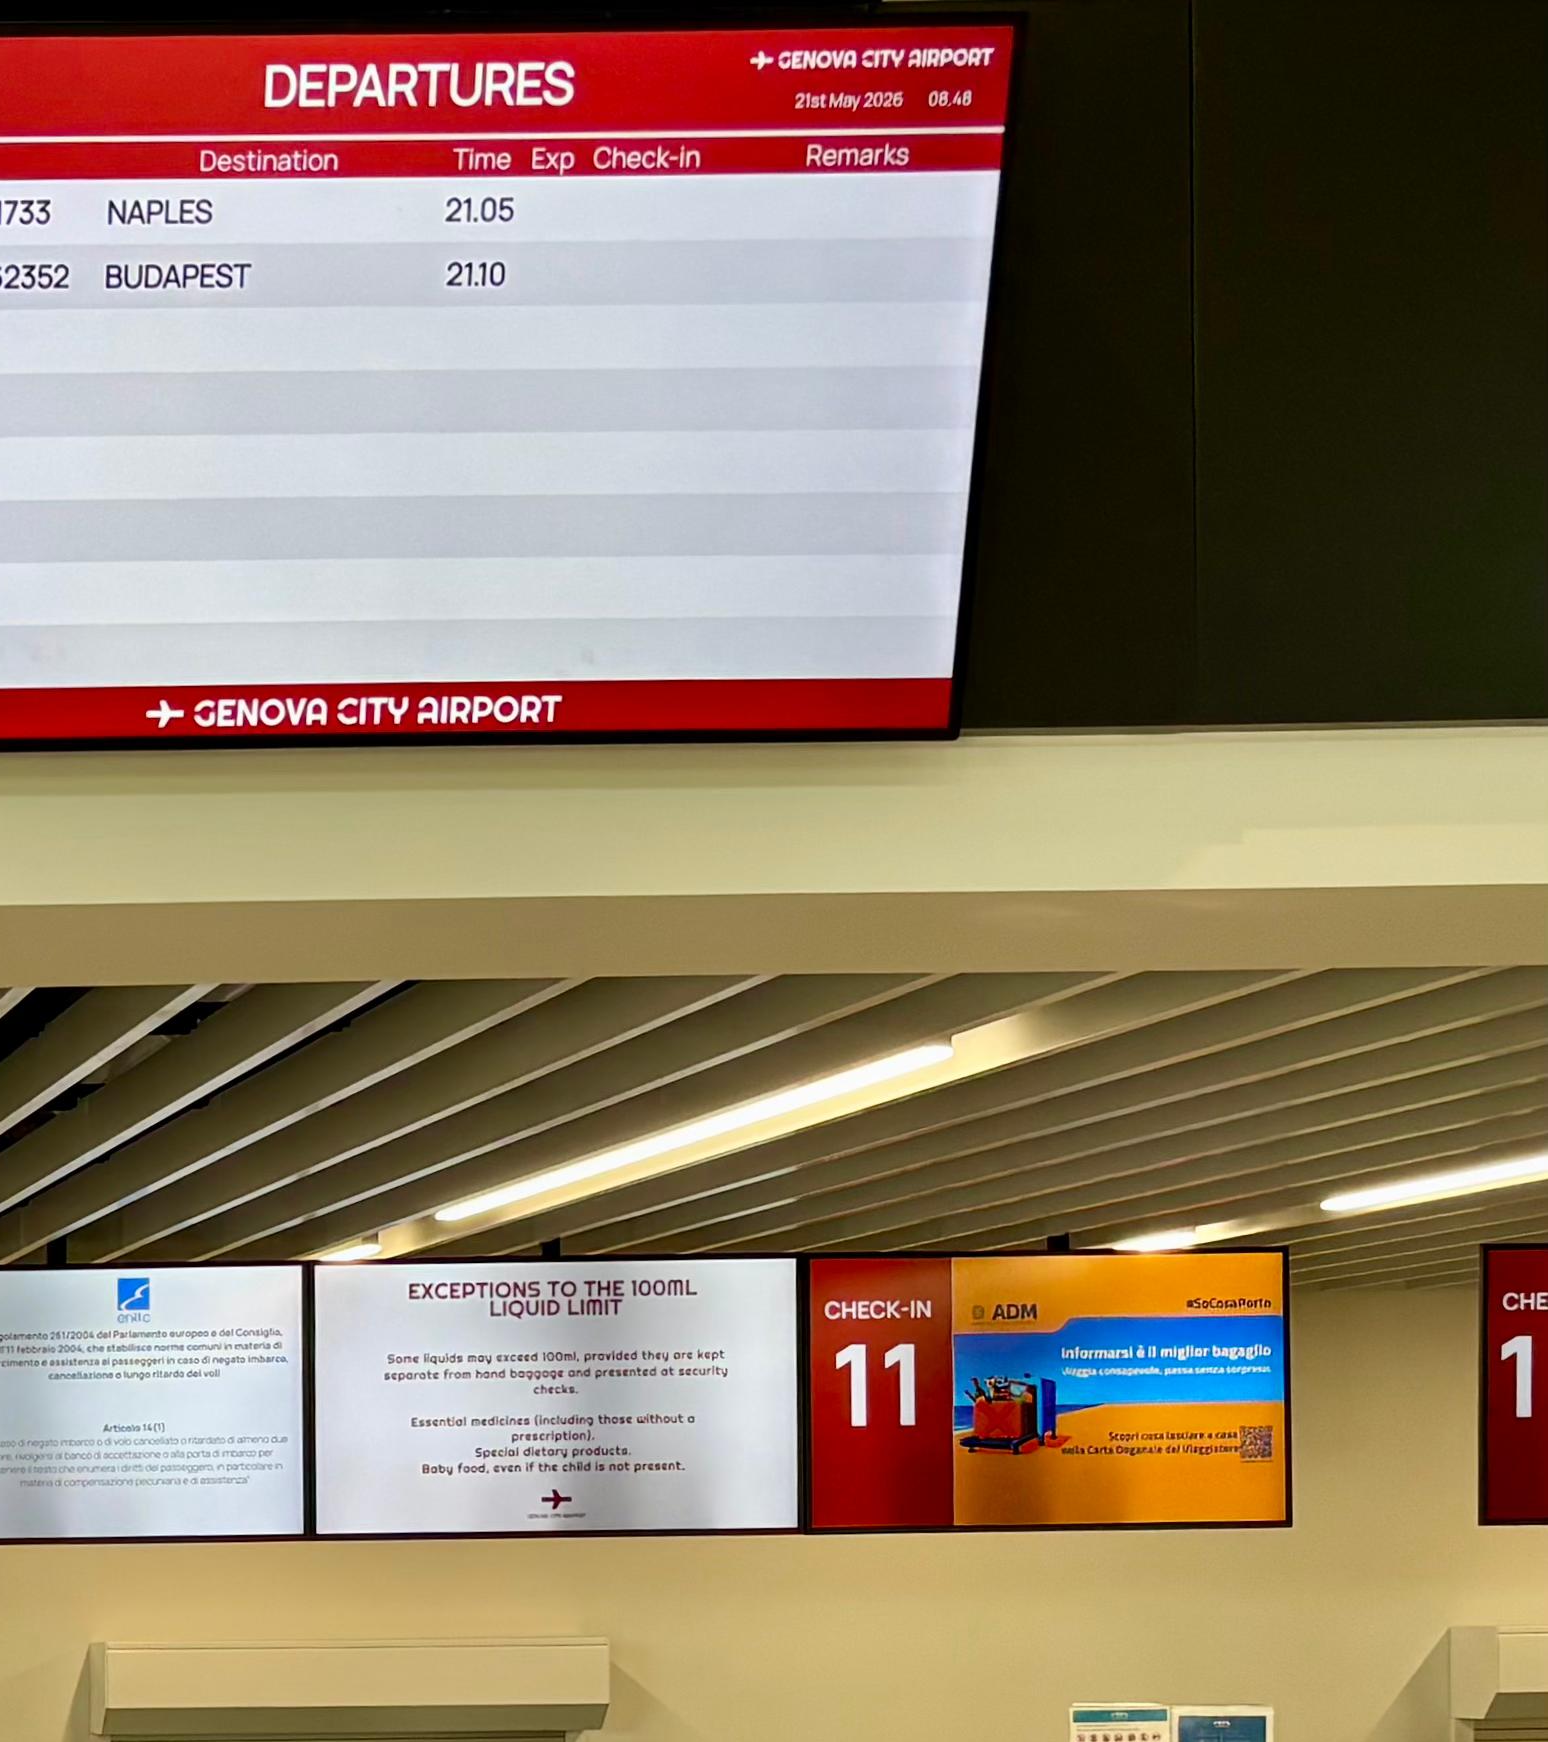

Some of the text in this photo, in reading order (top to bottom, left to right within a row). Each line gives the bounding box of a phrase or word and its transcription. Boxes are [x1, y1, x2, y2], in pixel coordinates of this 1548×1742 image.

[265, 61, 574, 107] DEPARTURES
[108, 199, 212, 224] NAPLES
[446, 197, 513, 222] 21.05
[106, 264, 251, 289] BUDAPEST
[447, 262, 505, 286] 21.10
[825, 1300, 931, 1319] CHECK-IN
[992, 1304, 1037, 1320] ADM
[836, 1344, 915, 1426] 11
